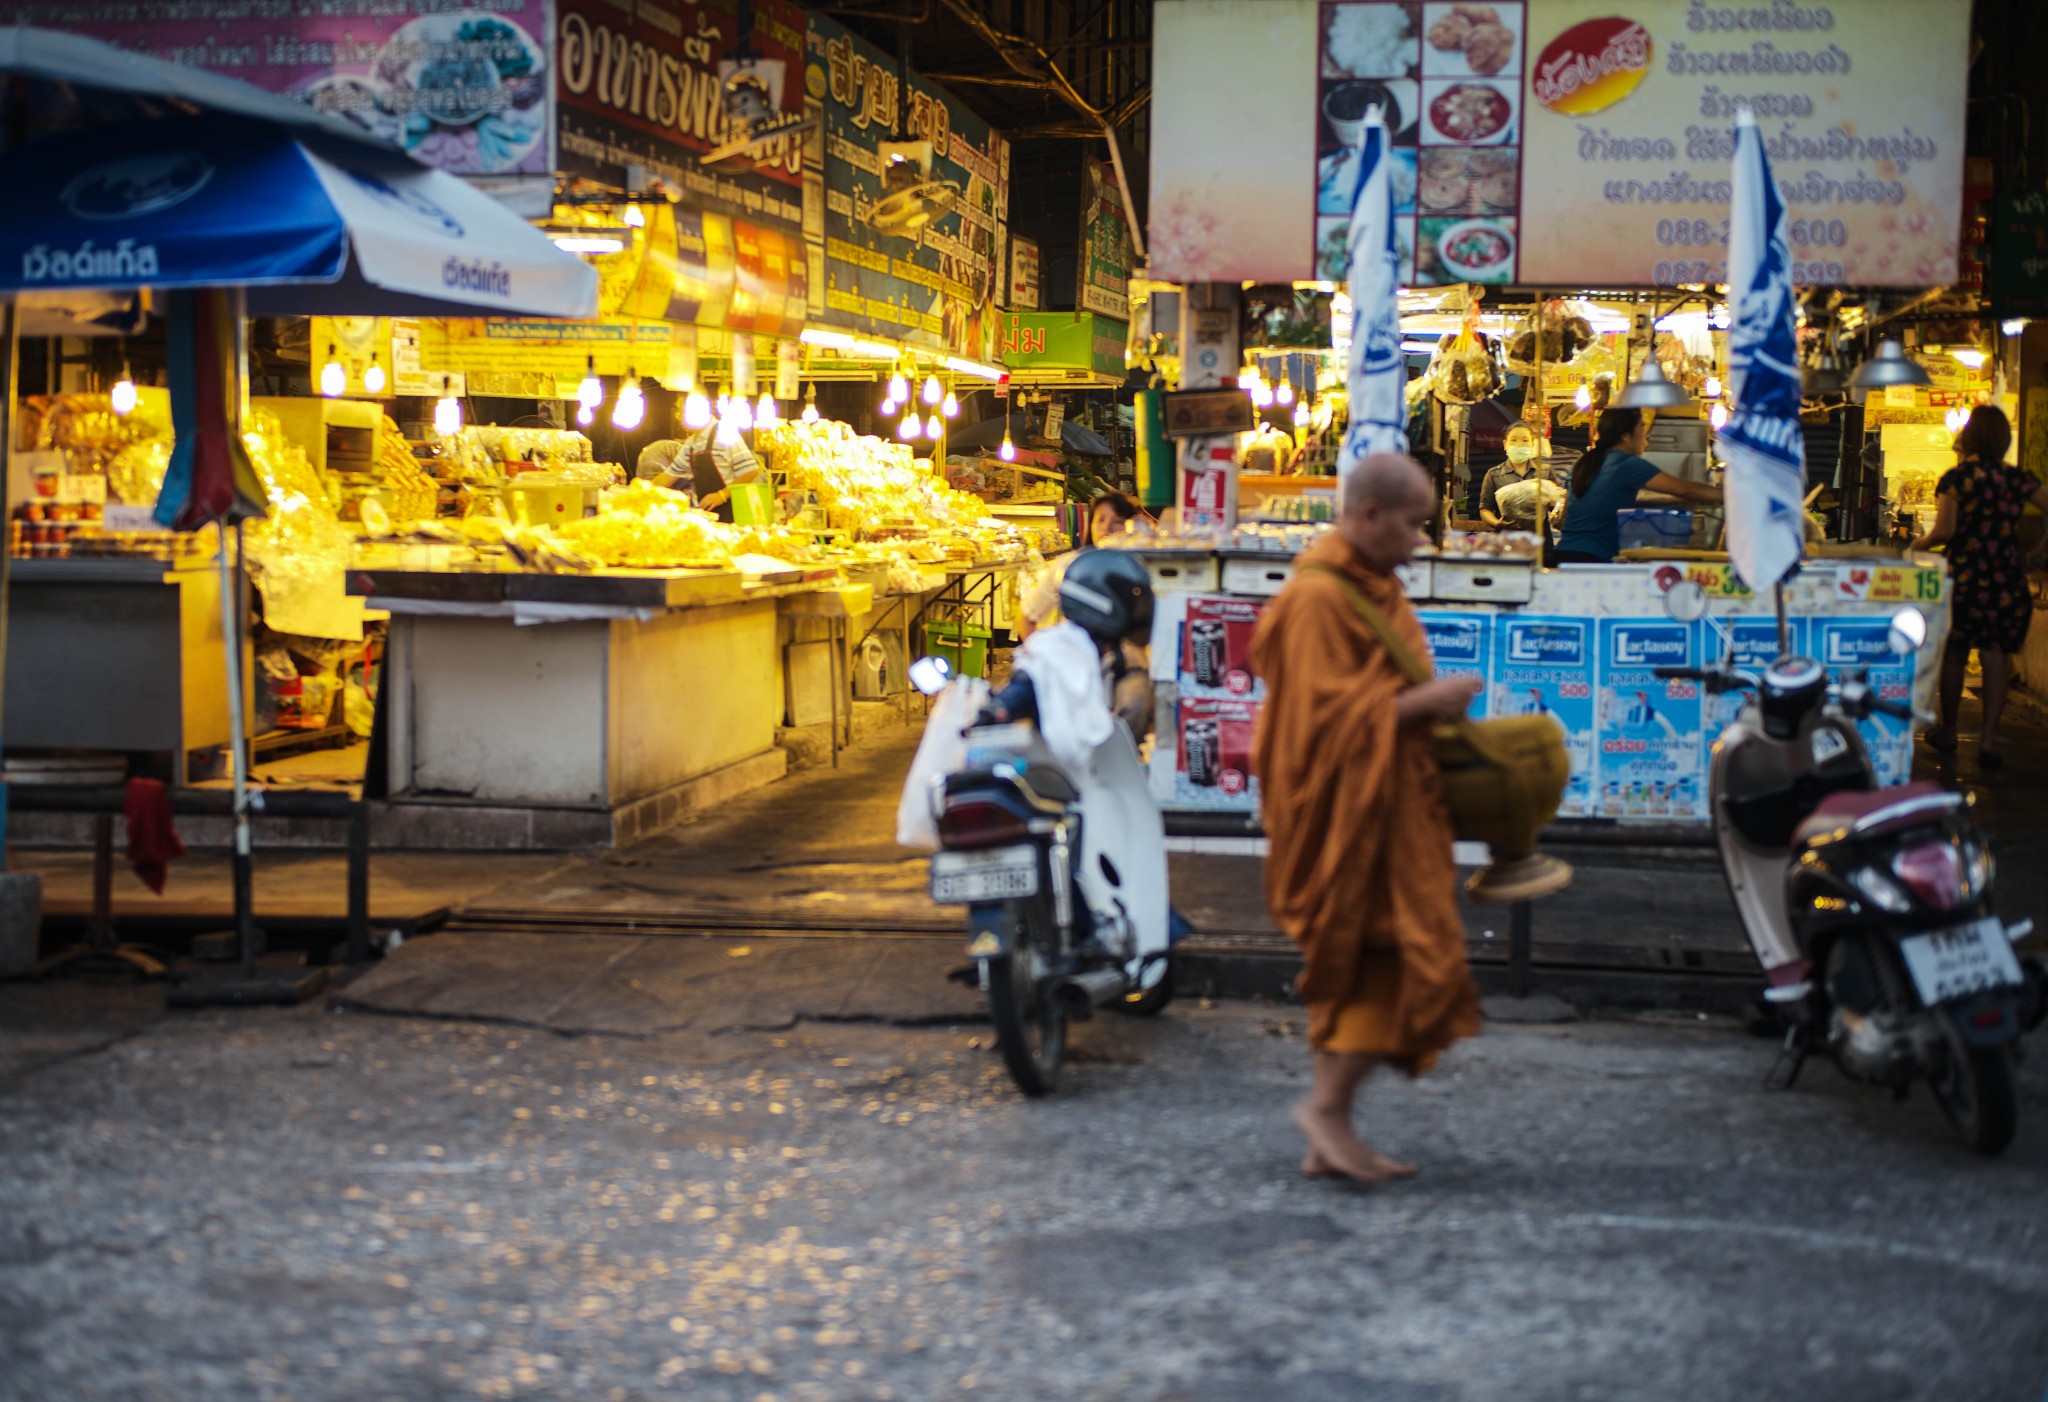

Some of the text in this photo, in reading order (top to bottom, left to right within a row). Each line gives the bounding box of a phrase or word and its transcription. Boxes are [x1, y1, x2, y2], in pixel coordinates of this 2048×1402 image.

[1576, 123, 1676, 161] ไก่ทอด
[1915, 570, 1941, 600] 15
[1510, 629, 1580, 660] Lactasoy
[1616, 631, 1687, 662] Lactasoy
[1559, 683, 1592, 699] 500
[1665, 685, 1698, 700] 500
